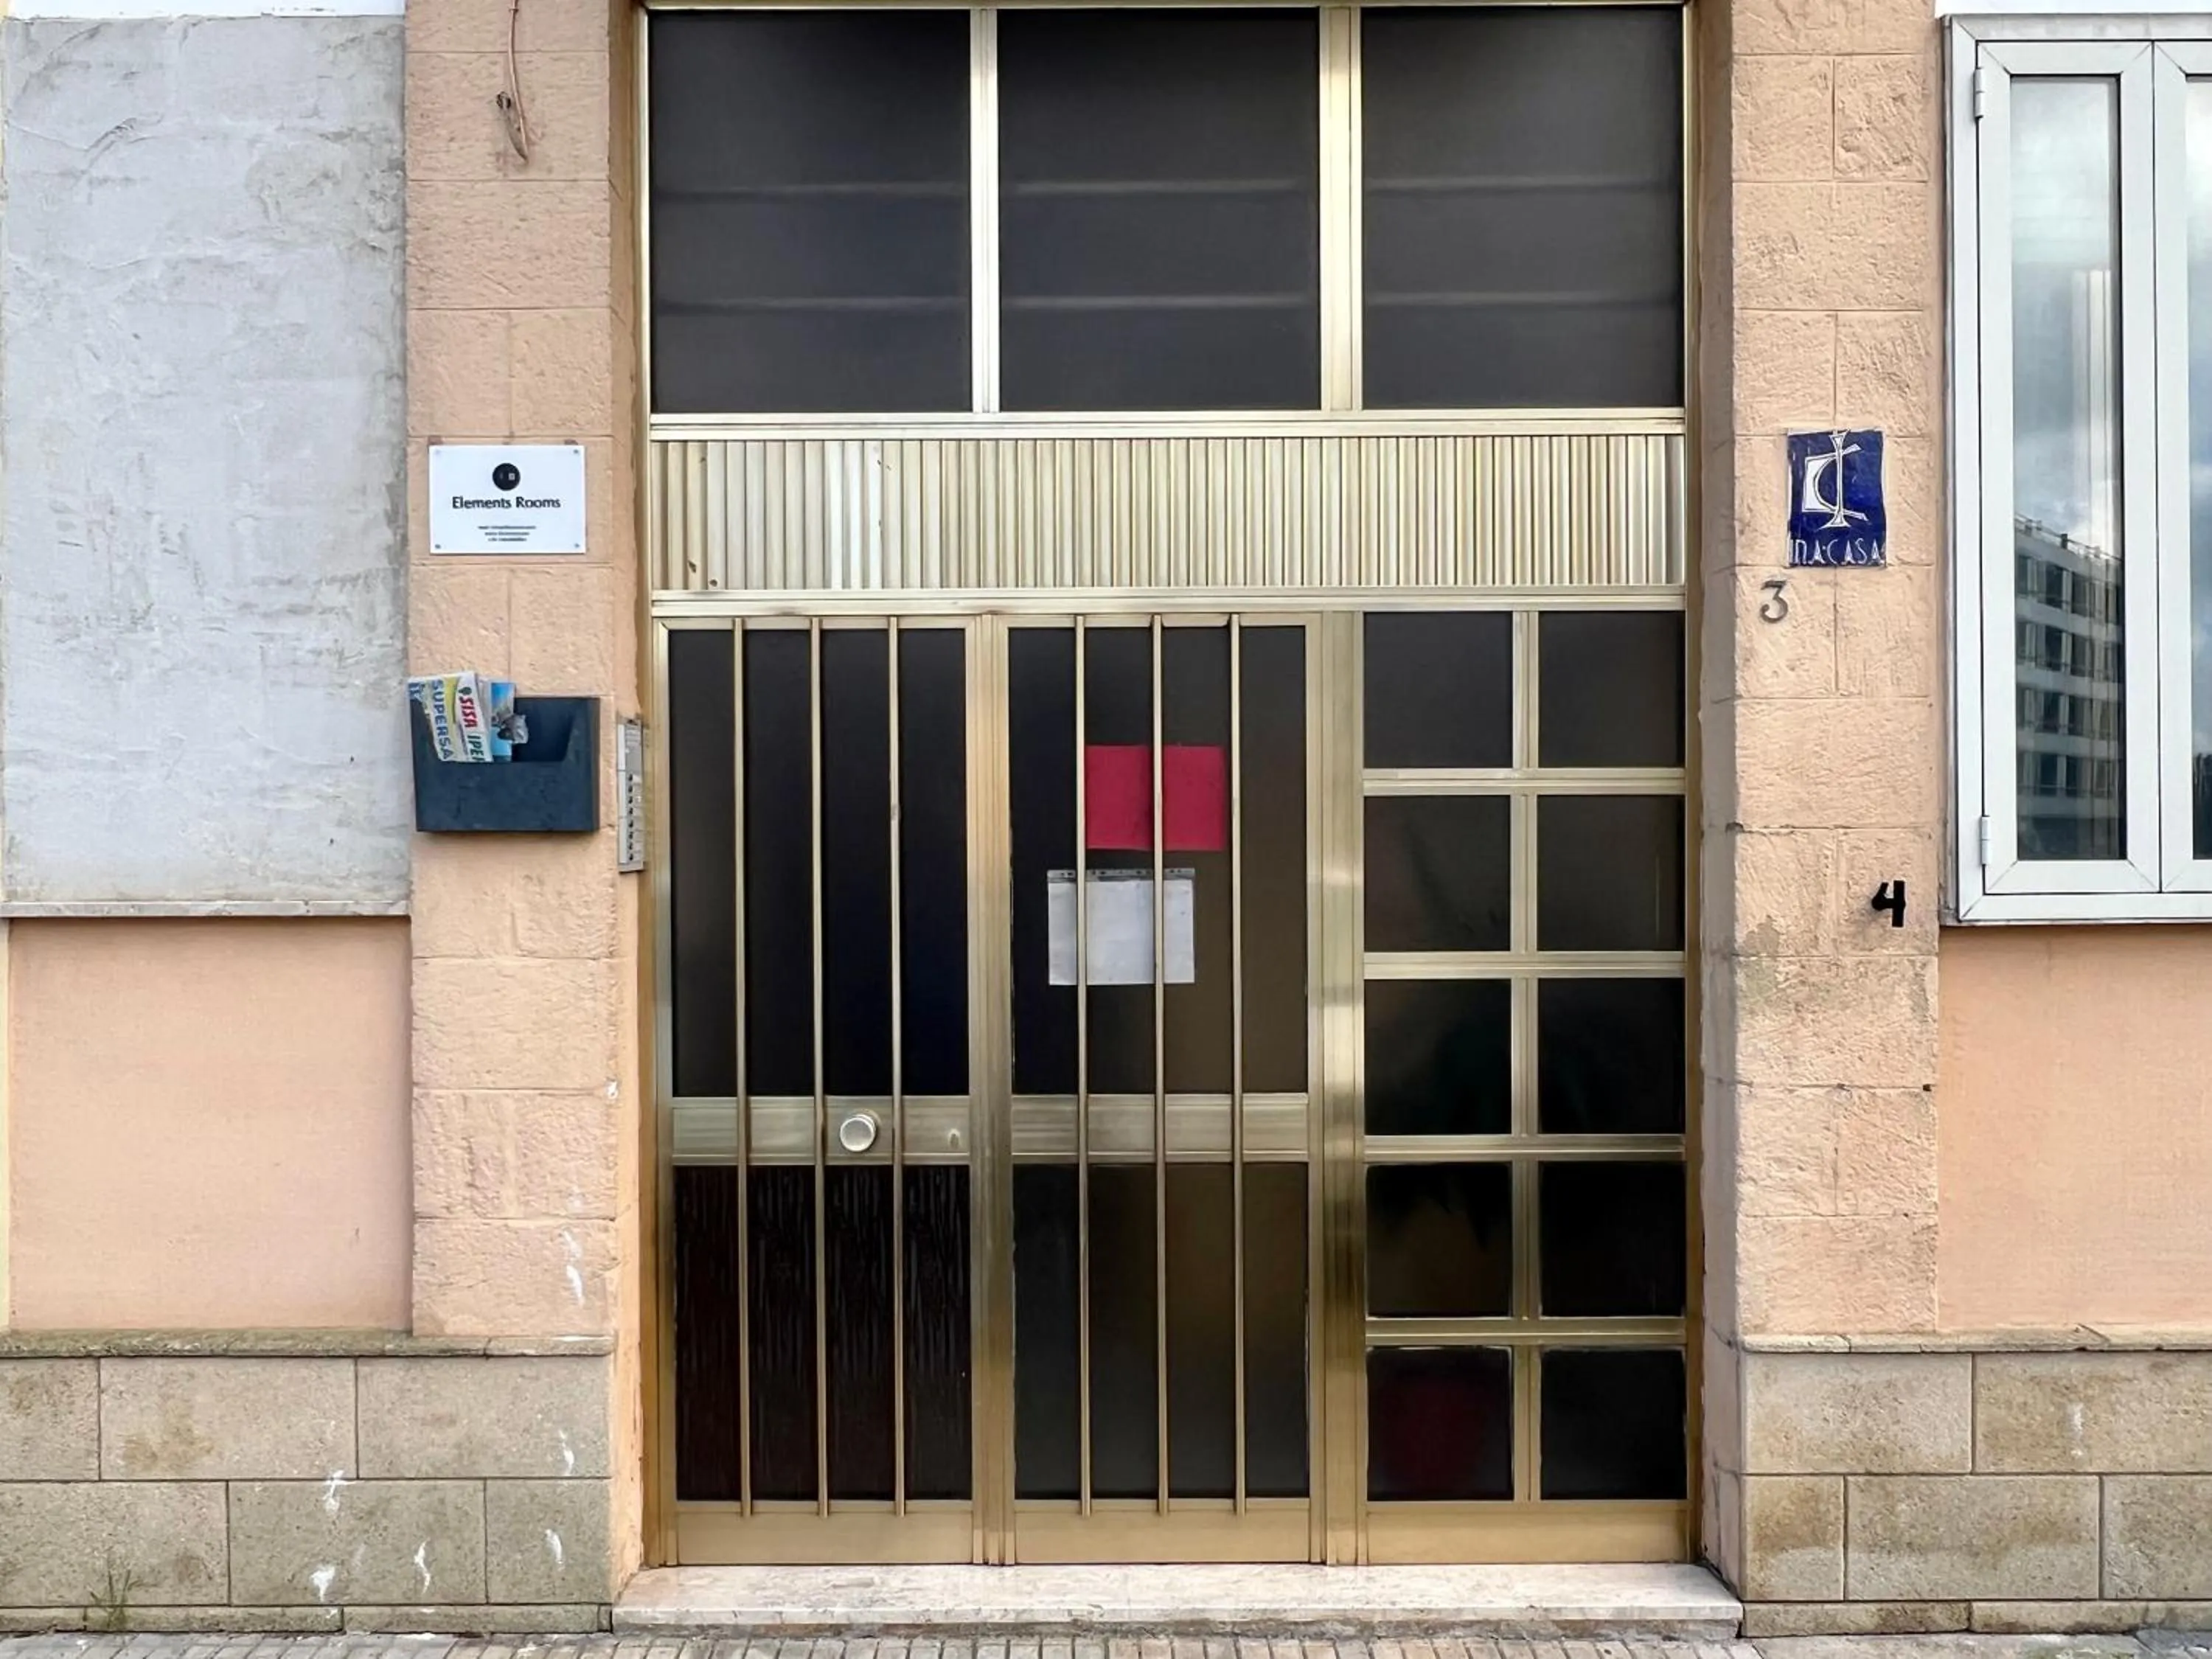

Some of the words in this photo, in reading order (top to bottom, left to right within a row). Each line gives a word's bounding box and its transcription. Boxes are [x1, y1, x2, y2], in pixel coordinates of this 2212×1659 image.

[452, 496, 512, 509] Elements
[515, 496, 561, 509] Rooms
[1760, 580, 1789, 623] 3
[459, 695, 478, 728] SISA
[1871, 880, 1906, 928] 4
